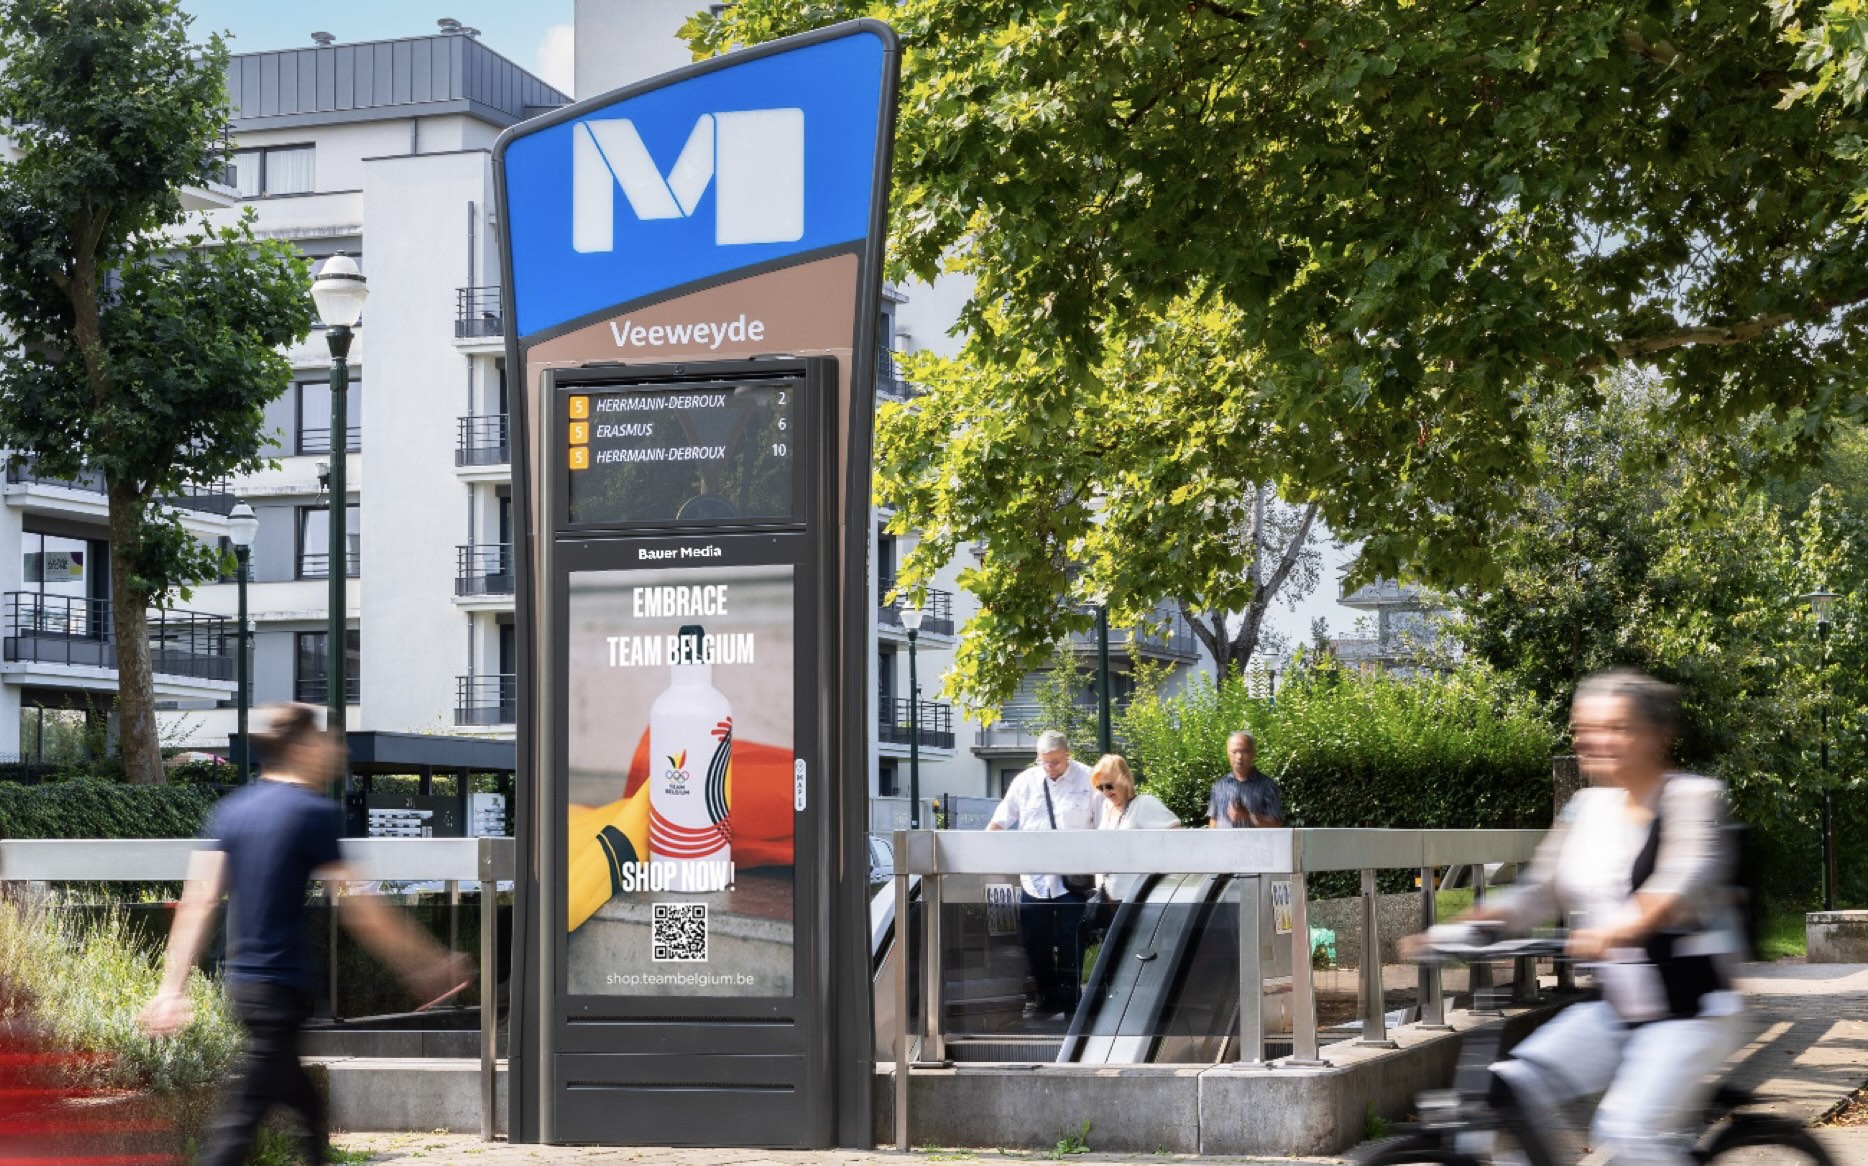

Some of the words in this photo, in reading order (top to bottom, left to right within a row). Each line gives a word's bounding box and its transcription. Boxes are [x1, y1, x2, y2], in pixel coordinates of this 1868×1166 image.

[572, 106, 805, 254] M
[609, 313, 765, 350] Veeweyde
[575, 400, 583, 413] 5
[596, 394, 726, 412] HERRMANN-DEBROUX
[778, 391, 787, 405] 2
[575, 425, 583, 438] 5
[596, 423, 653, 438] ERASMUS
[778, 417, 787, 431] 6
[575, 451, 583, 464] 5
[596, 446, 726, 463] HERRMANN-DEBROUX
[772, 443, 787, 457] 10
[638, 548, 678, 560] Bauer
[680, 544, 722, 558] Media
[632, 585, 729, 618] EMBRACE
[606, 634, 662, 668] TEAM
[665, 632, 755, 666] BELGIUM
[621, 861, 678, 892] SHOP
[606, 972, 755, 987] shop.teambelgium.be
